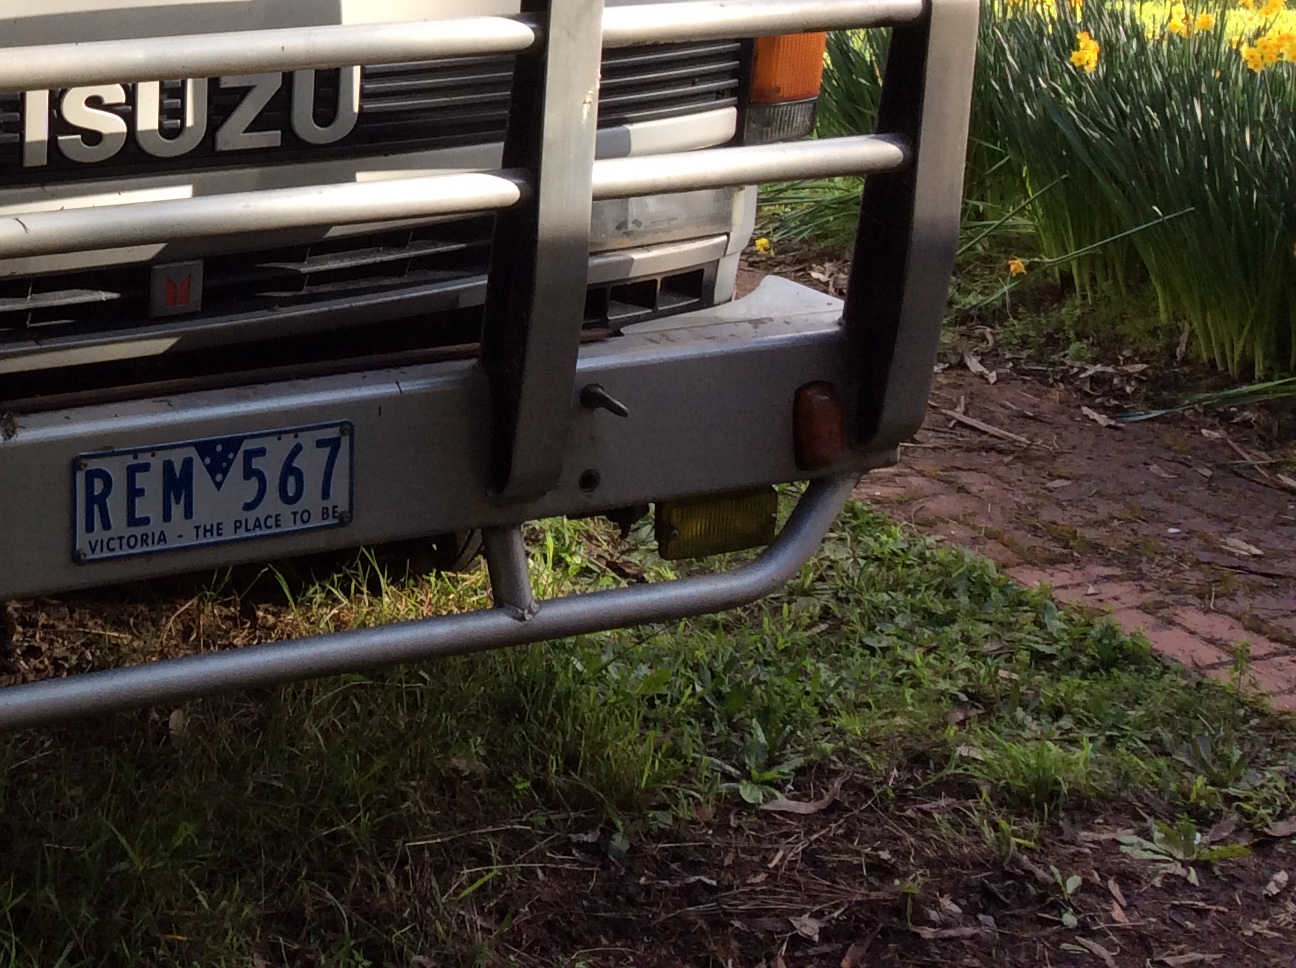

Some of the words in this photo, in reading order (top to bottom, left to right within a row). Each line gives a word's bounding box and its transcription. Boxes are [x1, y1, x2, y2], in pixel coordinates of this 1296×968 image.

[23, 65, 361, 167] ISUZU
[85, 456, 194, 533] REM
[242, 436, 341, 512] 567
[88, 530, 168, 555] VICTORIA
[193, 522, 224, 540] THE
[233, 513, 282, 534] PLACE
[291, 509, 312, 525] TO
[321, 505, 340, 521] BE
